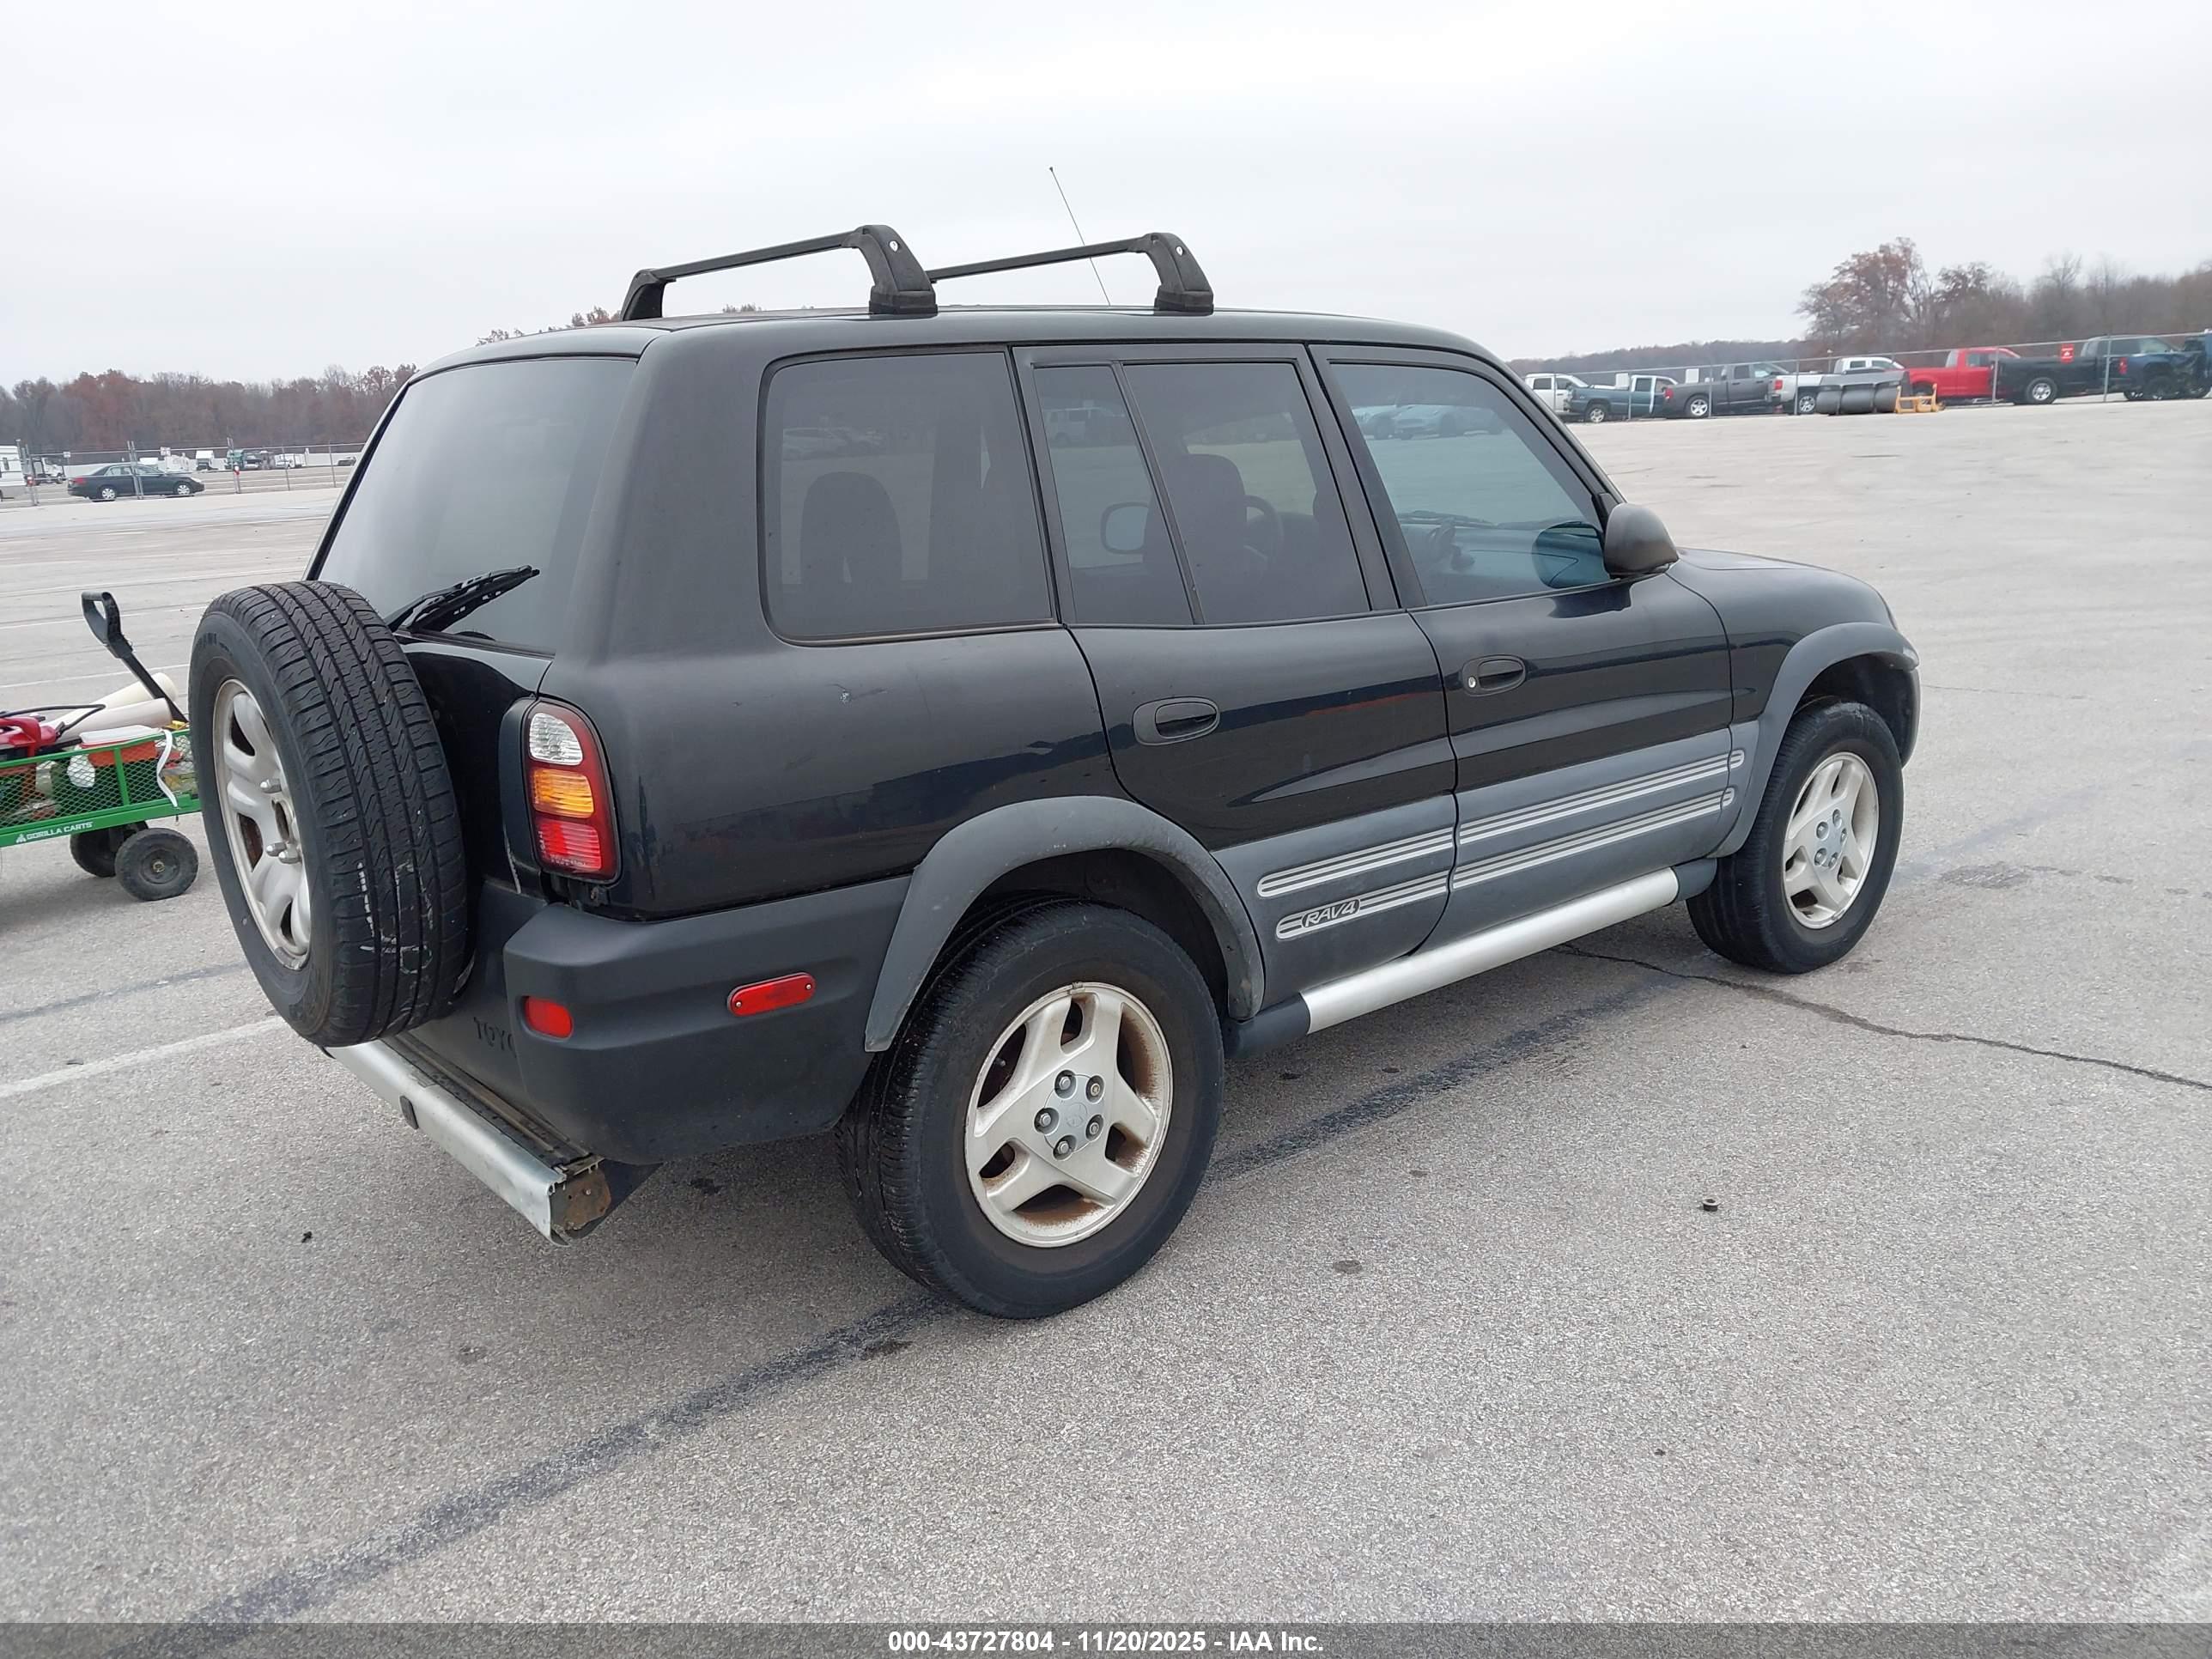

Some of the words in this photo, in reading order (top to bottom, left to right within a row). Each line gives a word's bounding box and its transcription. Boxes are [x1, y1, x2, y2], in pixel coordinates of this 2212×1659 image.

[27, 829, 63, 840] GORILLA
[64, 822, 93, 833] CARTS
[1304, 901, 1355, 927] RAV4
